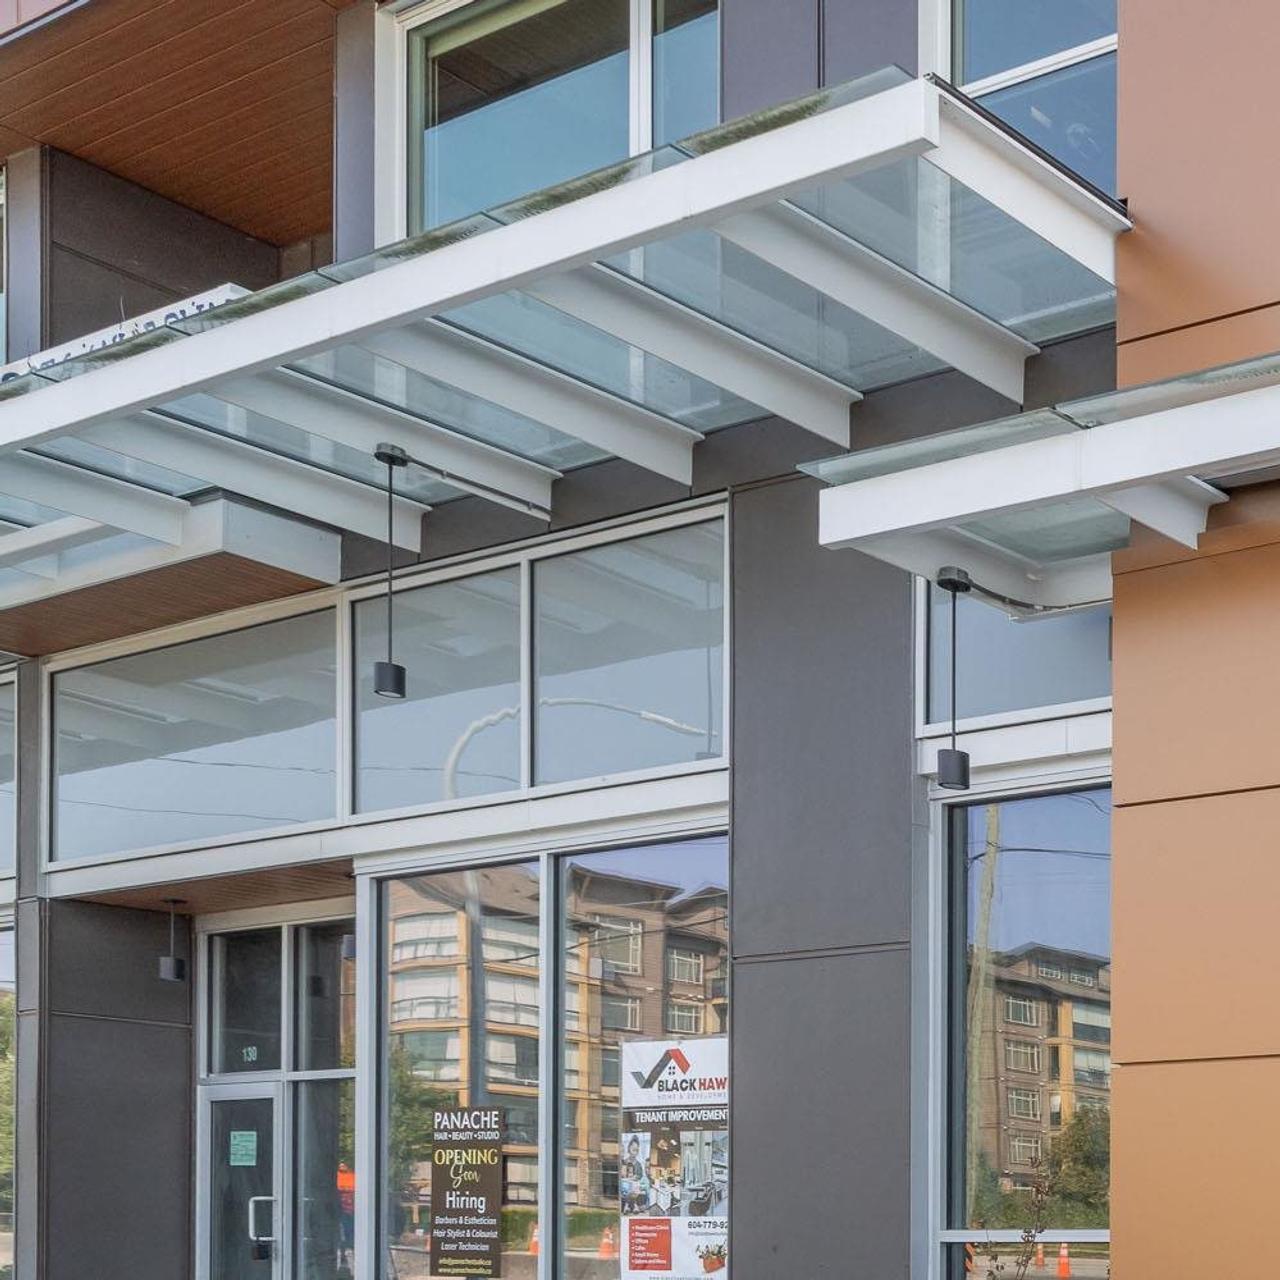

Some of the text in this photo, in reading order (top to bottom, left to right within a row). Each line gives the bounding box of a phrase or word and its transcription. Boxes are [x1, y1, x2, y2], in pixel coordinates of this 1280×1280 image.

[657, 1079, 696, 1092] BLACK
[434, 1111, 499, 1129] PANACHE
[635, 1111, 667, 1123] TENANT
[434, 1131, 500, 1140] HAIR BEAUTY STUDIO
[434, 1148, 498, 1165] OPENING
[446, 1190, 486, 1213] Hiring
[433, 1229, 446, 1238] Hair
